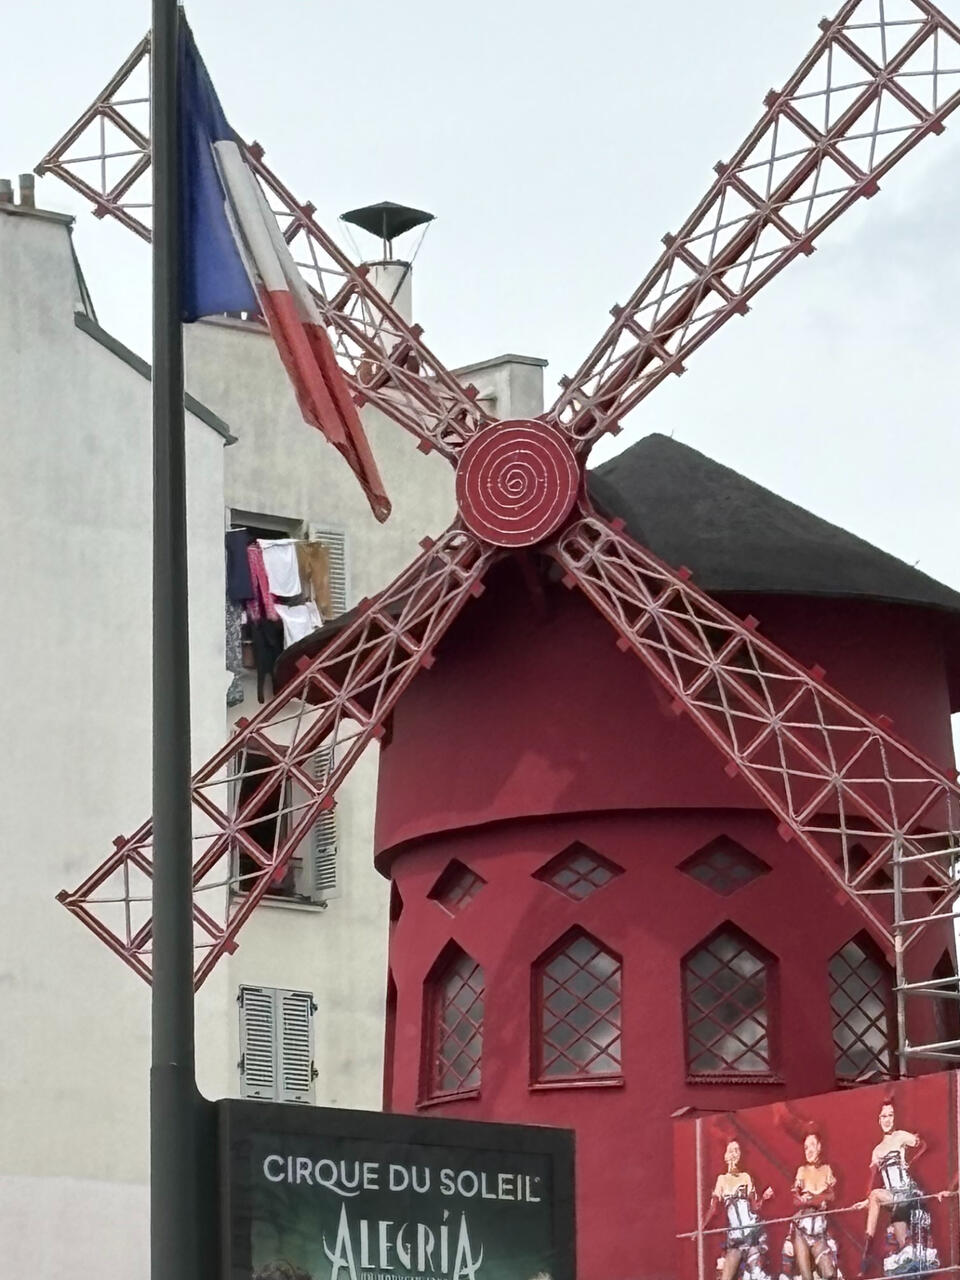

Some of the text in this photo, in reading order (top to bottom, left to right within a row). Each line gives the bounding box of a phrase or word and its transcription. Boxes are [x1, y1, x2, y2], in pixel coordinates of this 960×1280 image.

[263, 1155, 541, 1203] CIRQUE DU SOLEIL
